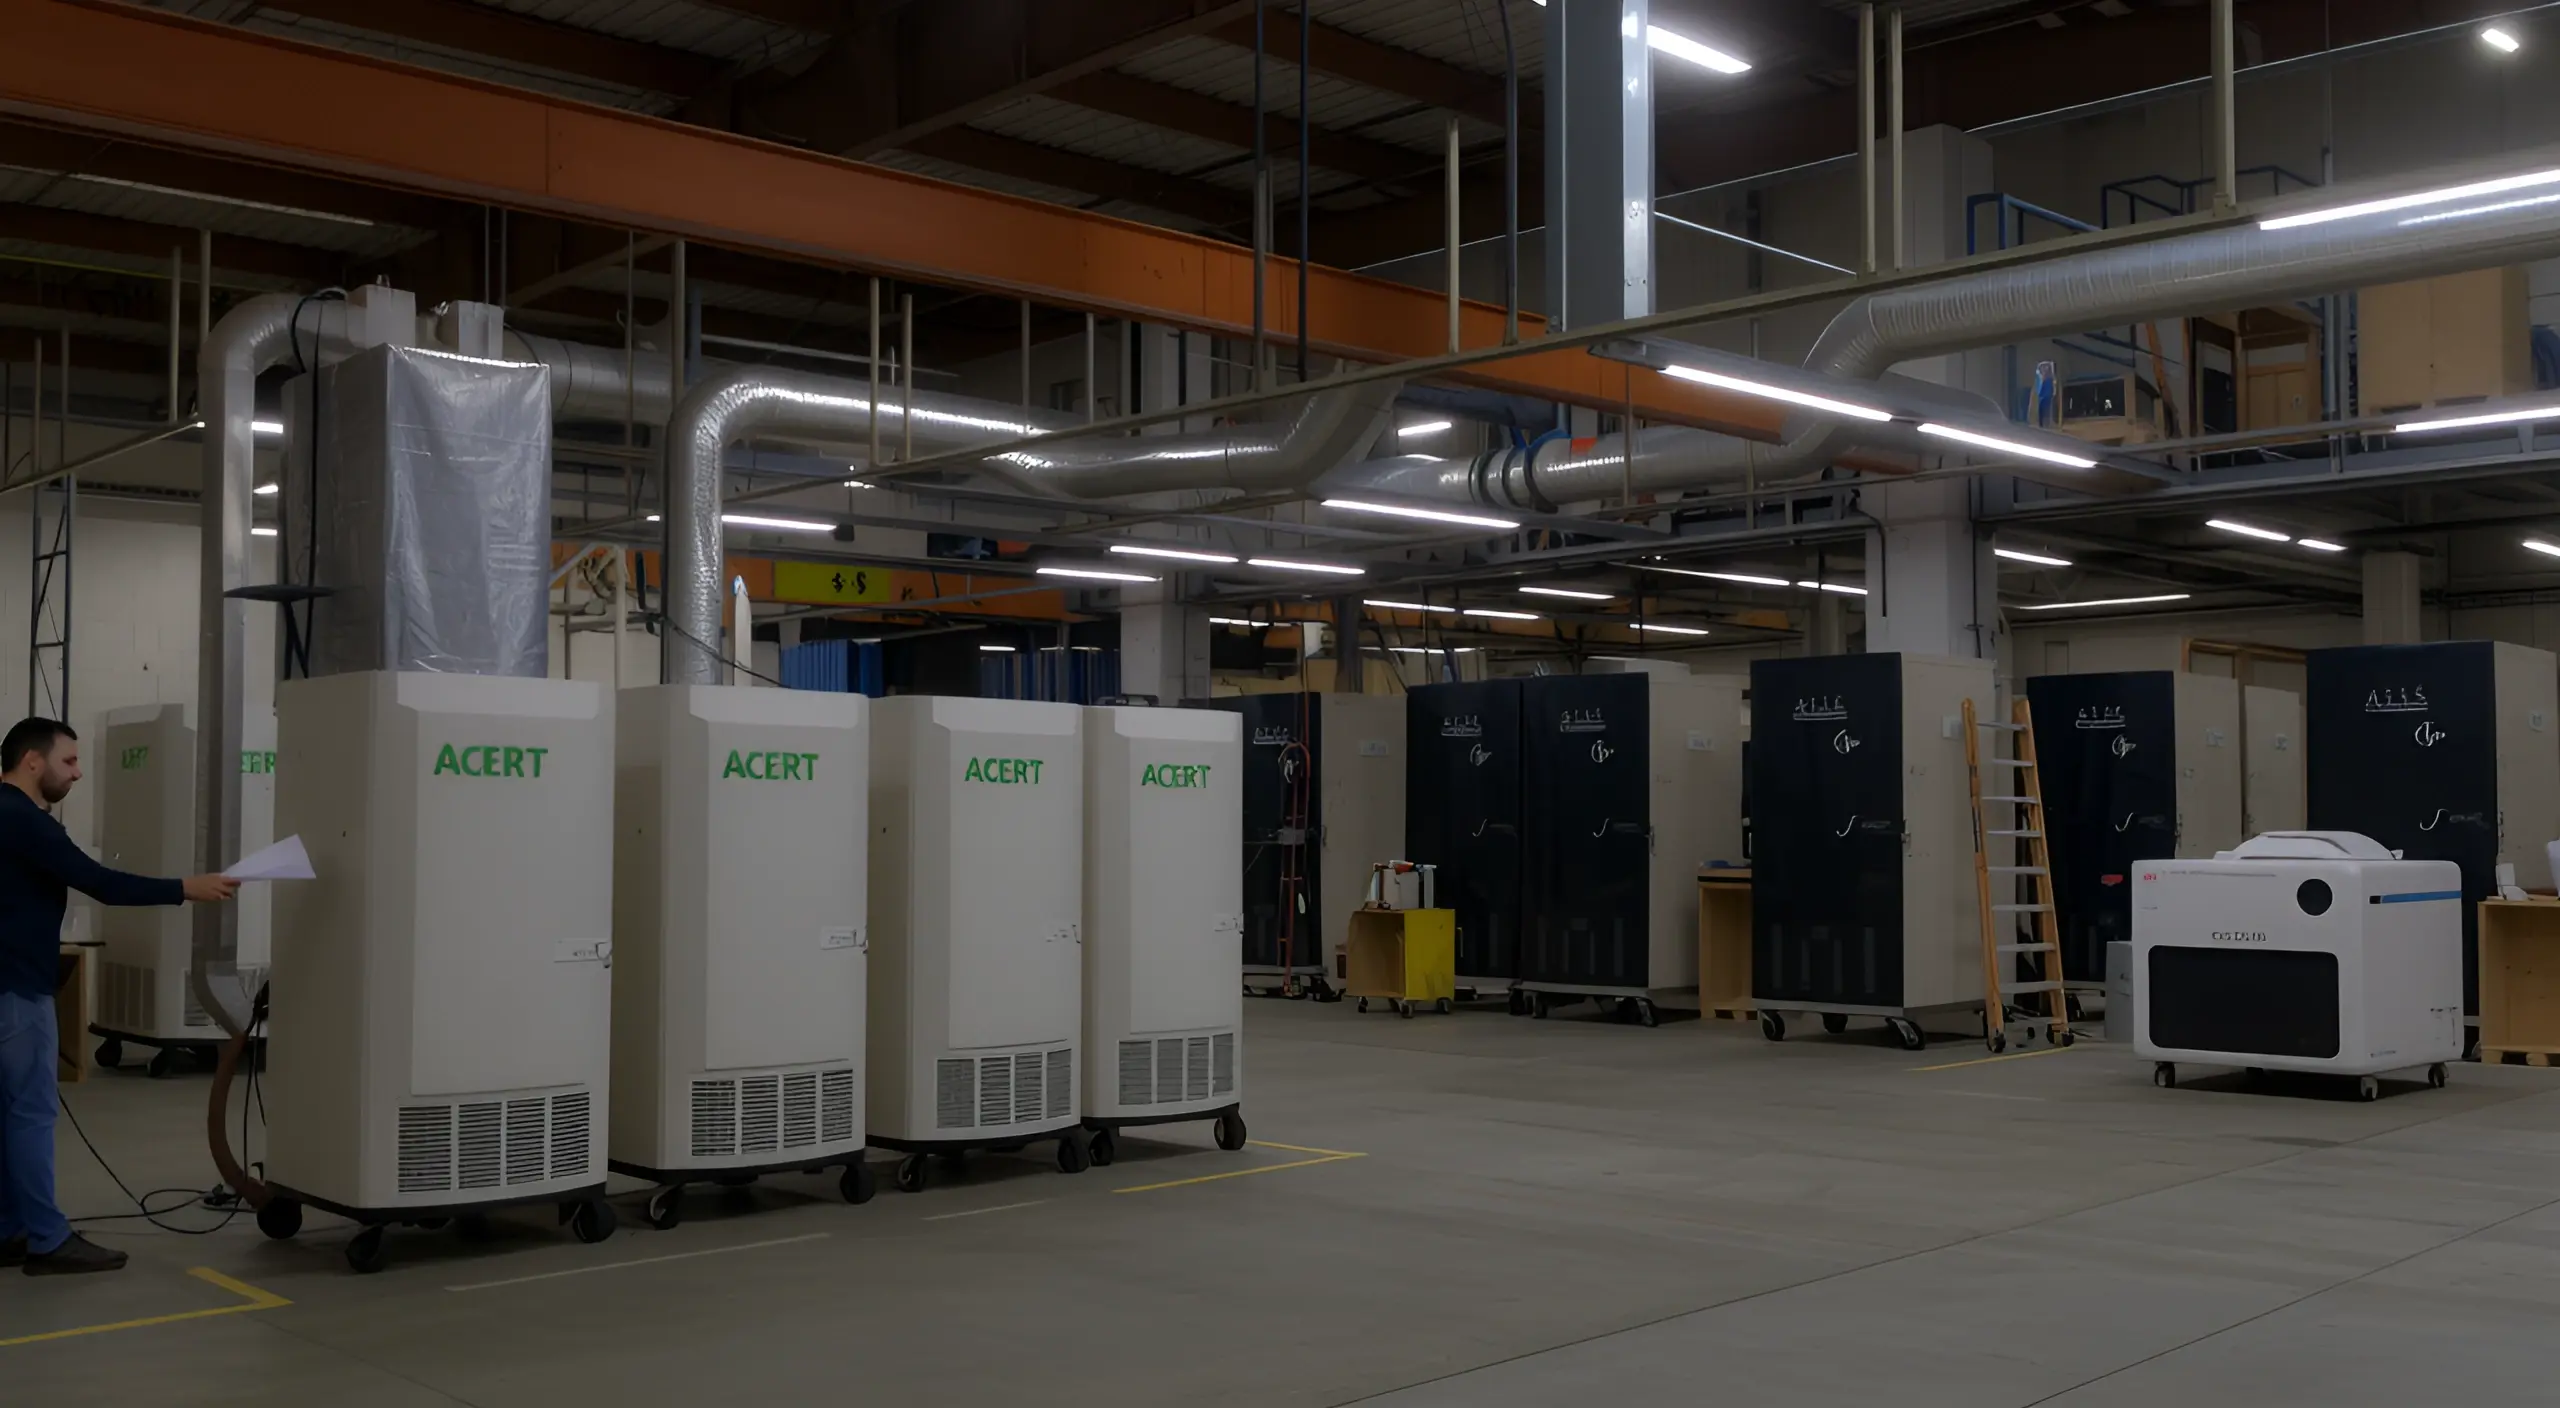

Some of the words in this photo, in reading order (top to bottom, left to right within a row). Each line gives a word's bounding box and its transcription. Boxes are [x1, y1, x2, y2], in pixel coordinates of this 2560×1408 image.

[434, 743, 548, 778] ACERT
[722, 749, 819, 781] ACERT
[964, 757, 1043, 784] ACERT
